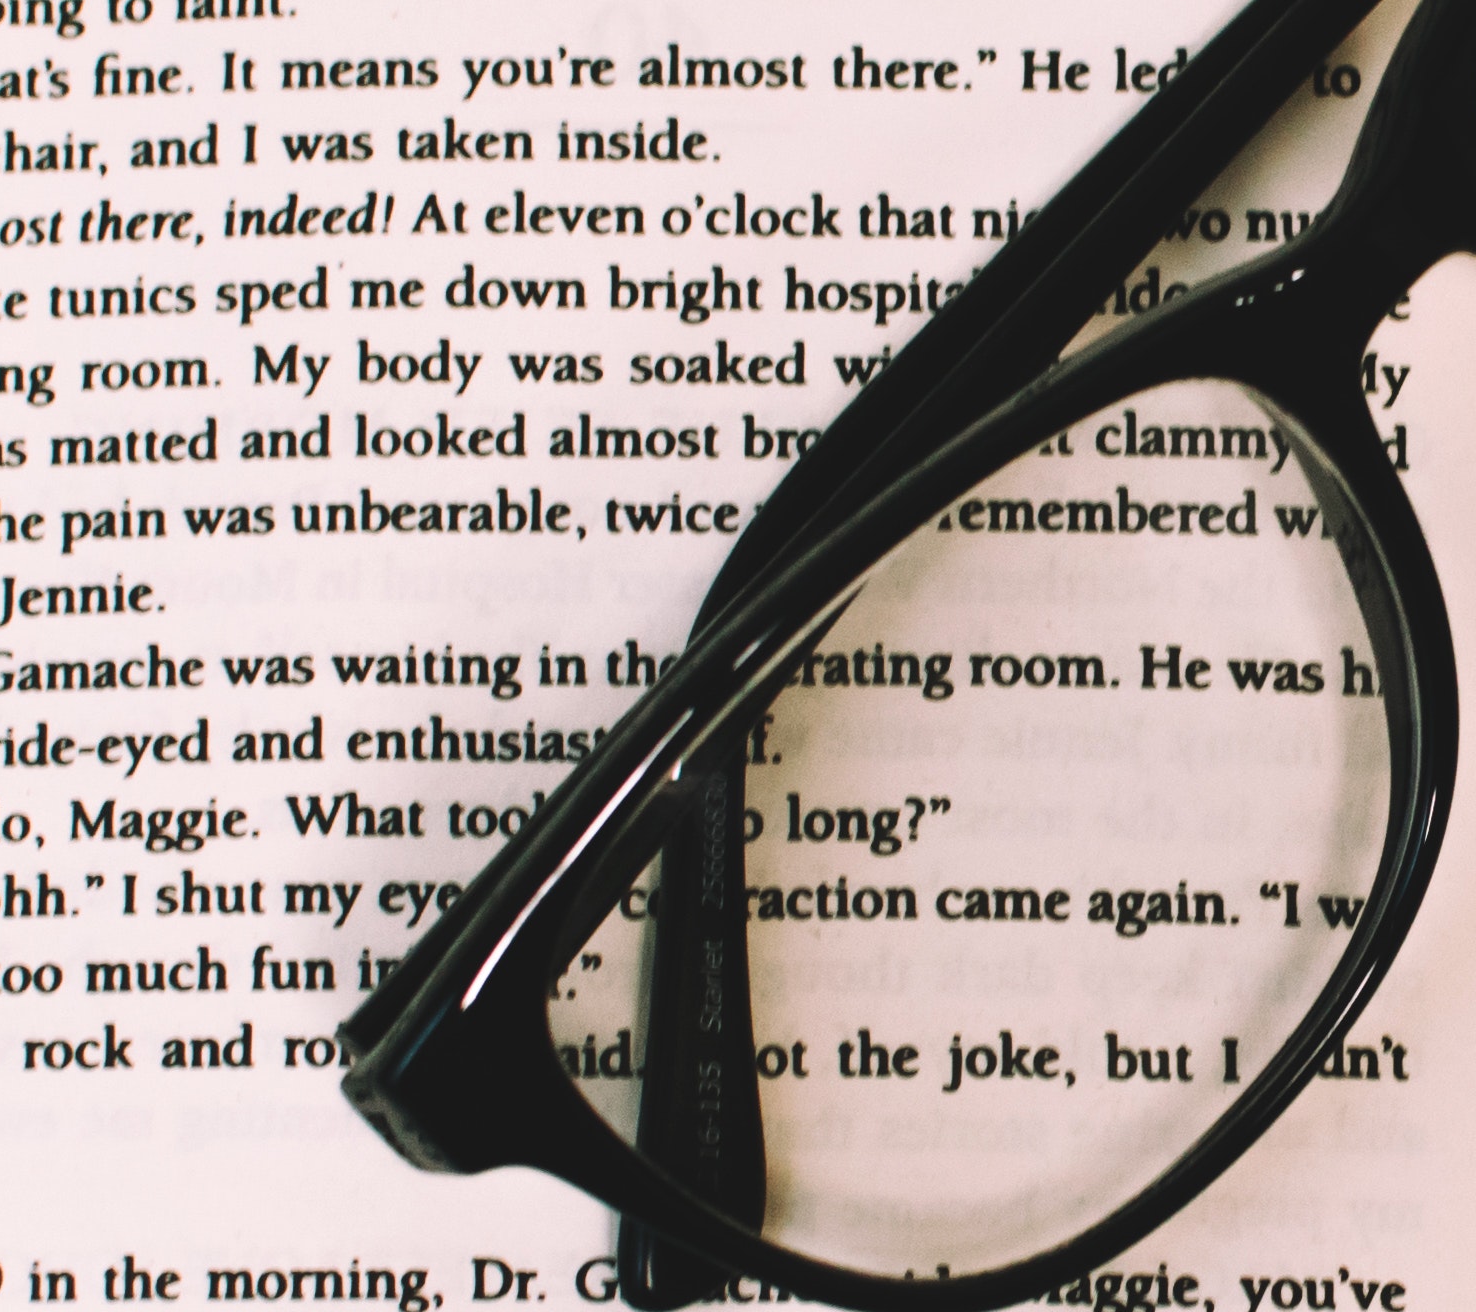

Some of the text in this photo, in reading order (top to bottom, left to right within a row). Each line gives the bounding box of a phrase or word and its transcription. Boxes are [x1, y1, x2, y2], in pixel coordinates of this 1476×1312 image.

[221, 655, 315, 686] was
[331, 644, 522, 702] waiting
[539, 644, 588, 687] in
[606, 639, 679, 687] th
[969, 653, 1119, 688] room.
[1140, 645, 1211, 690] He
[1227, 660, 1325, 694] was
[699, 938, 724, 1034] Starlet
